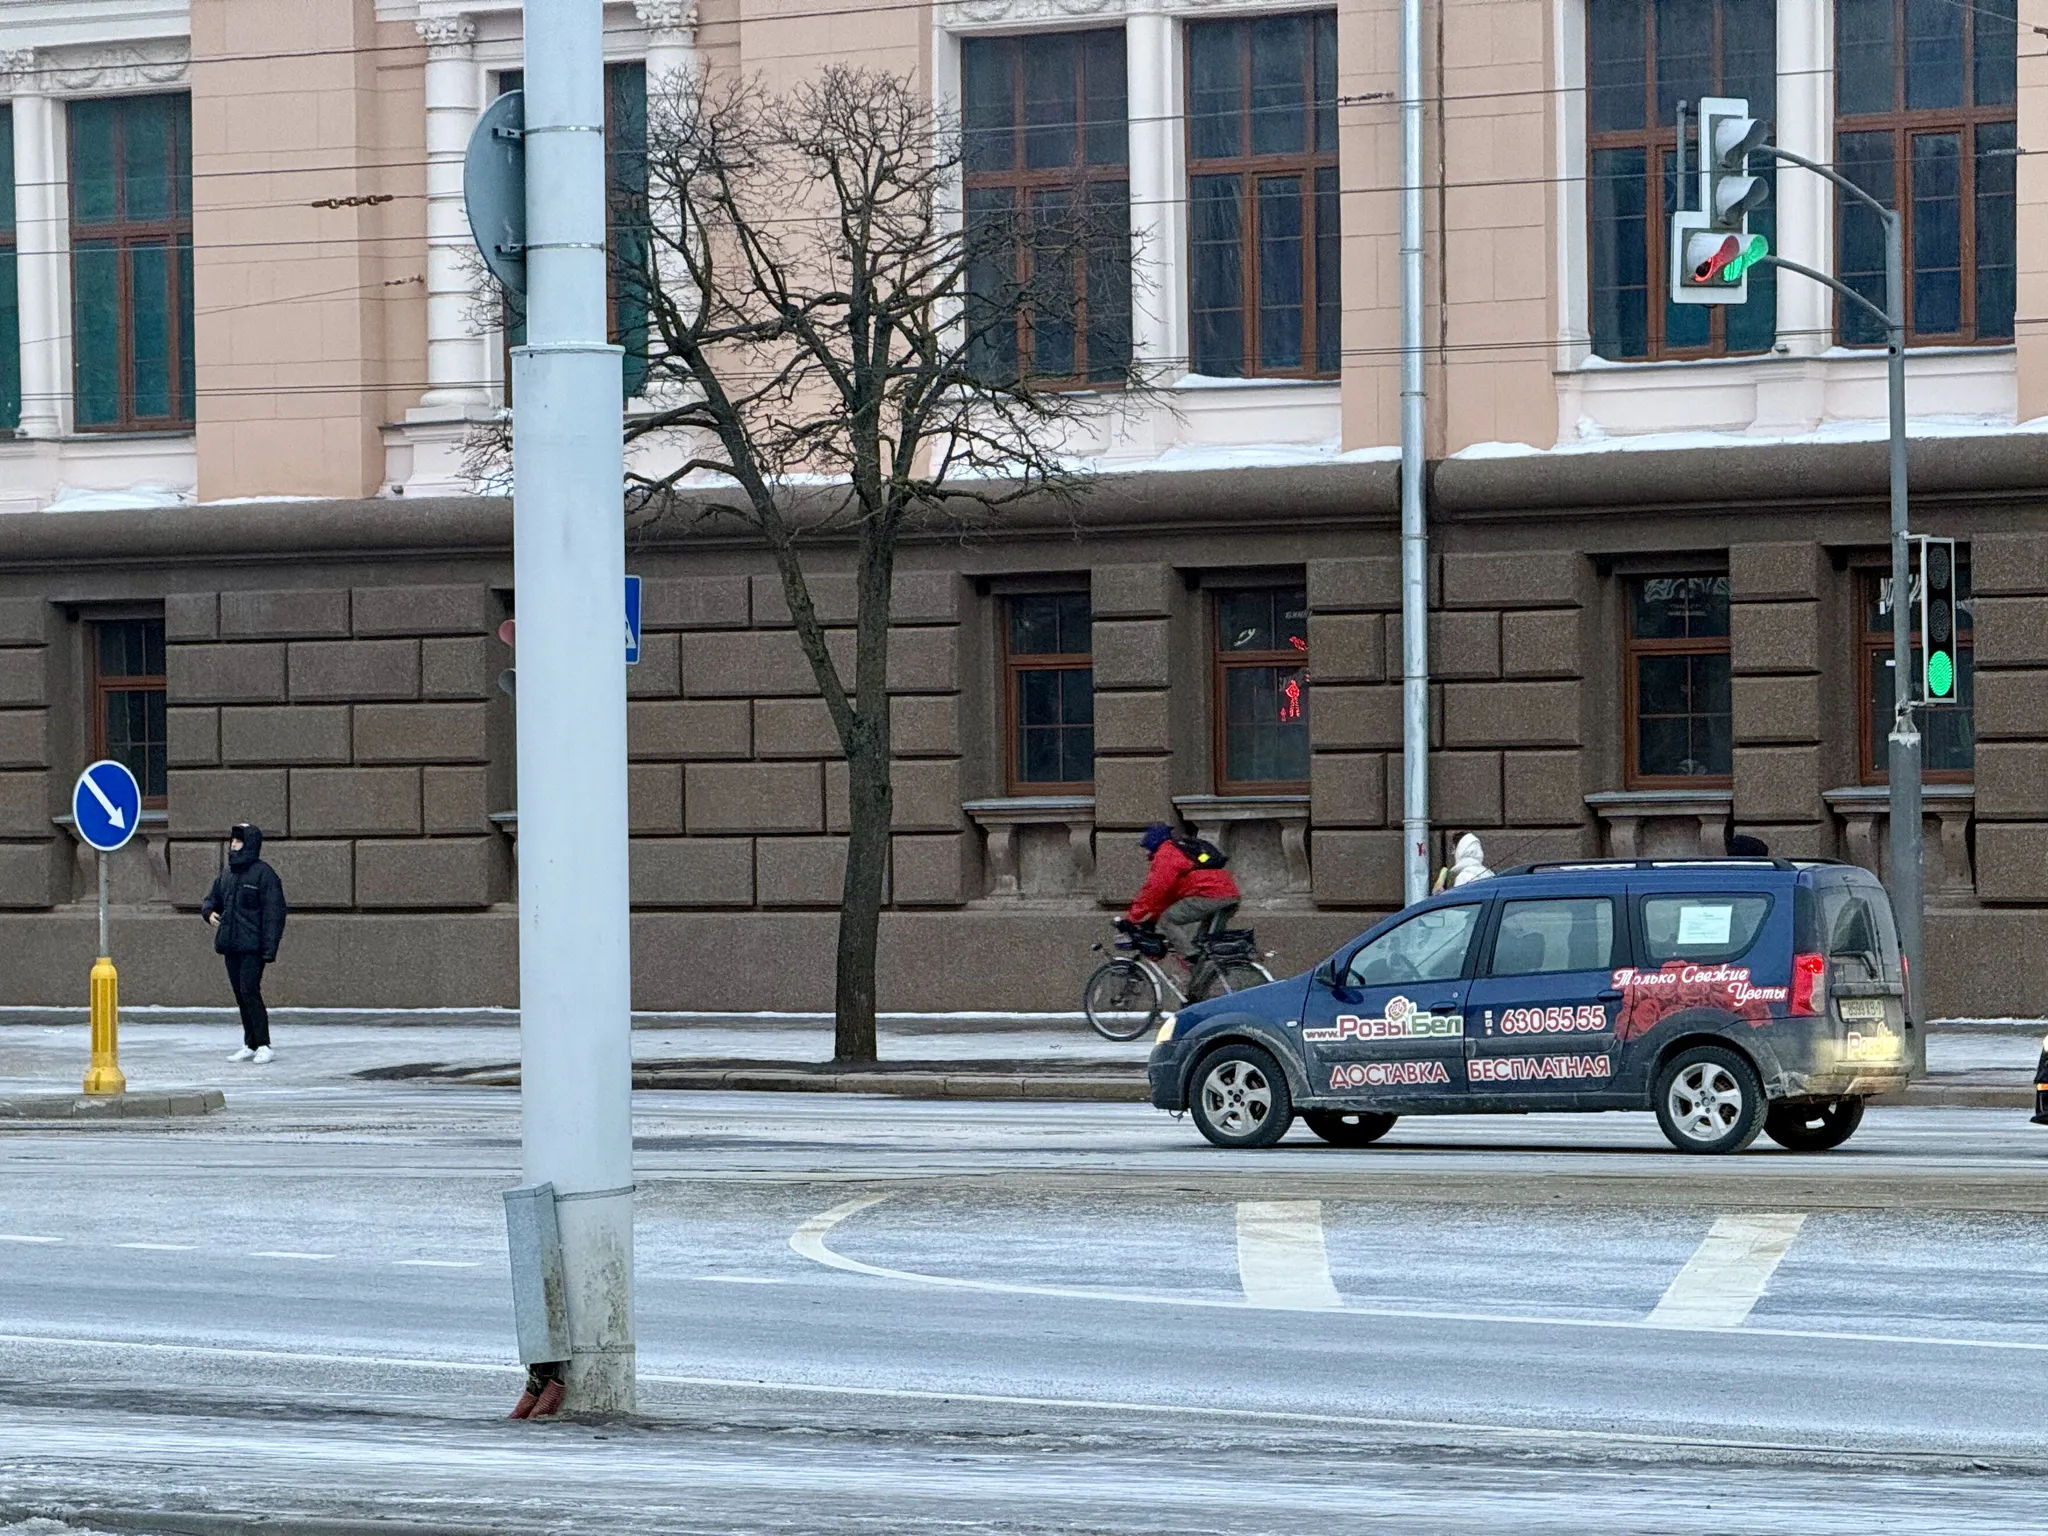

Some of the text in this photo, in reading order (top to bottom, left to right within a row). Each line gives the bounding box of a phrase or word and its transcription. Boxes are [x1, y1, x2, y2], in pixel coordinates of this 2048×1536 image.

[1613, 964, 1749, 989] Только Свежие
[1727, 983, 1787, 1007] Цветы
[1331, 1055, 1611, 1089] ДОСТАВКА БЕСПЛАТНАЯ
